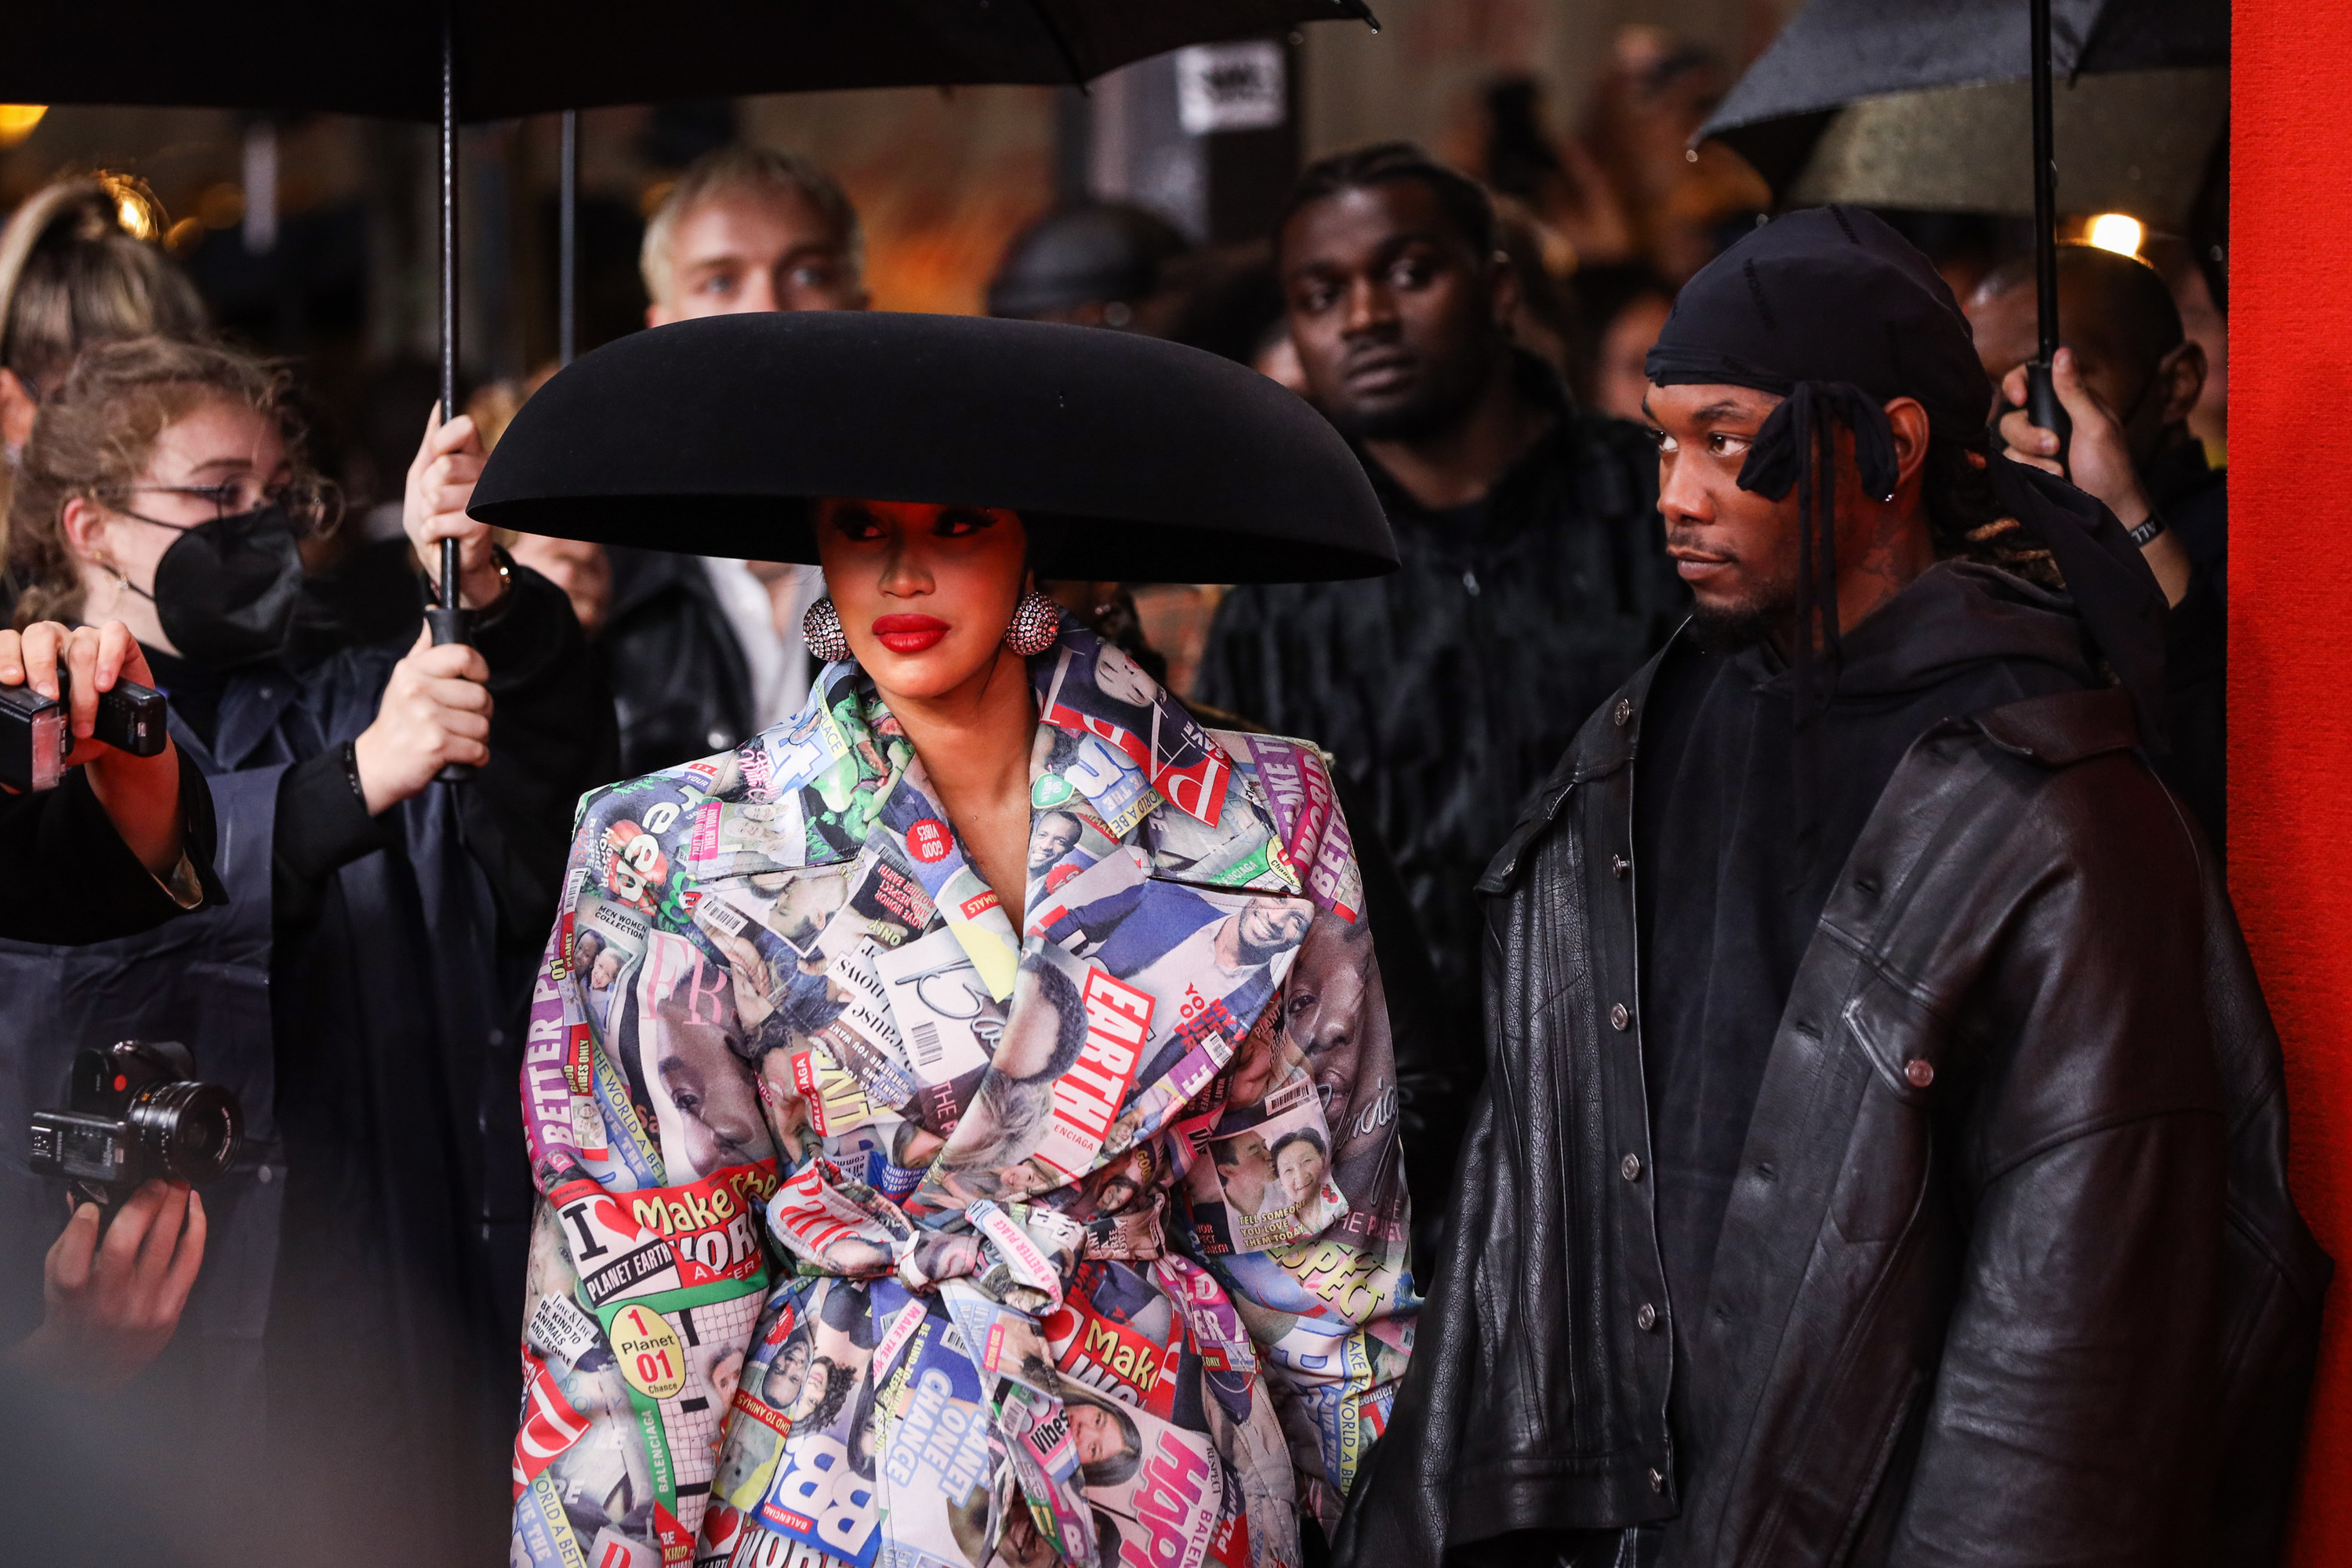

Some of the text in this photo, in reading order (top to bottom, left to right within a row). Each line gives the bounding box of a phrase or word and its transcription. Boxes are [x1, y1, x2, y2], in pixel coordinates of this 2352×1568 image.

[821, 713, 843, 753] PLACE
[1184, 720, 1225, 760] SAVE
[685, 773, 709, 787] YOUR
[1126, 809, 1138, 820] A
[1294, 753, 1336, 864] WORLD
[704, 808, 719, 850] THEM TODAY
[916, 823, 939, 841] VIBES
[921, 840, 944, 858] GOOD
[877, 863, 906, 887] EARTH
[874, 888, 924, 931] LOVE HONOR
[879, 879, 931, 917] AND RESPECT
[594, 911, 645, 941] COLLECTION
[598, 904, 648, 934] MEN WOMEN
[868, 917, 902, 947] ONLY
[564, 931, 574, 969] PLANET
[550, 958, 567, 981] 01
[1254, 1004, 1283, 1040] PLANT
[577, 1039, 590, 1094] VIBES ONLY
[827, 1023, 910, 1093] WHENEVER YOU WANT
[1053, 974, 1150, 1134] EARTH
[526, 1015, 576, 1149] BETTER
[563, 1064, 579, 1093] GOOD
[862, 1066, 902, 1103] WANT AND
[605, 1073, 638, 1134] WORLD
[637, 1138, 648, 1152] A
[931, 1078, 958, 1120] THE
[632, 1188, 736, 1236] Make
[1238, 1200, 1307, 1226] TELL SOMEONE
[1240, 1219, 1289, 1237] YOU LOVE
[561, 1200, 609, 1262] I
[993, 1219, 1020, 1247] PLACE
[1243, 1224, 1306, 1248] THEM TODAY
[586, 1259, 633, 1302] PLANET
[633, 1242, 673, 1278] EARTH
[1016, 1242, 1046, 1276] BETTER
[1040, 1274, 1048, 1283] A
[535, 1311, 567, 1346] ANIMALS
[539, 1300, 581, 1345] BE KIND TO
[552, 1294, 571, 1316] Love
[575, 1316, 592, 1338] Live
[627, 1308, 648, 1337] 1
[880, 1305, 922, 1359] MAKE THE
[917, 1322, 932, 1338] BE
[530, 1320, 546, 1341] AND
[543, 1336, 572, 1367] PEOPLE
[621, 1334, 676, 1355] Planet
[907, 1338, 926, 1366] KIND
[1206, 1356, 1221, 1367] ONLY
[636, 1348, 674, 1384] 01
[1348, 1373, 1369, 1395] THE
[648, 1383, 678, 1395] Chance
[764, 1410, 777, 1423] TO
[886, 1370, 953, 1485] CHANGE
[1030, 1407, 1071, 1456] Vibes
[1341, 1397, 1356, 1448] WORLD
[641, 1409, 670, 1494] BALENCIAGA
[922, 1408, 967, 1470] ONE
[1206, 1446, 1222, 1495] RESPECT
[1342, 1452, 1355, 1463] A
[764, 1504, 808, 1530] BALENCIAGA
[1120, 1430, 1210, 1568] HAP
[1216, 1470, 1238, 1555] PLANET
[551, 1525, 566, 1537] A
[660, 1530, 676, 1545] BE
[664, 1544, 688, 1561] KIND
